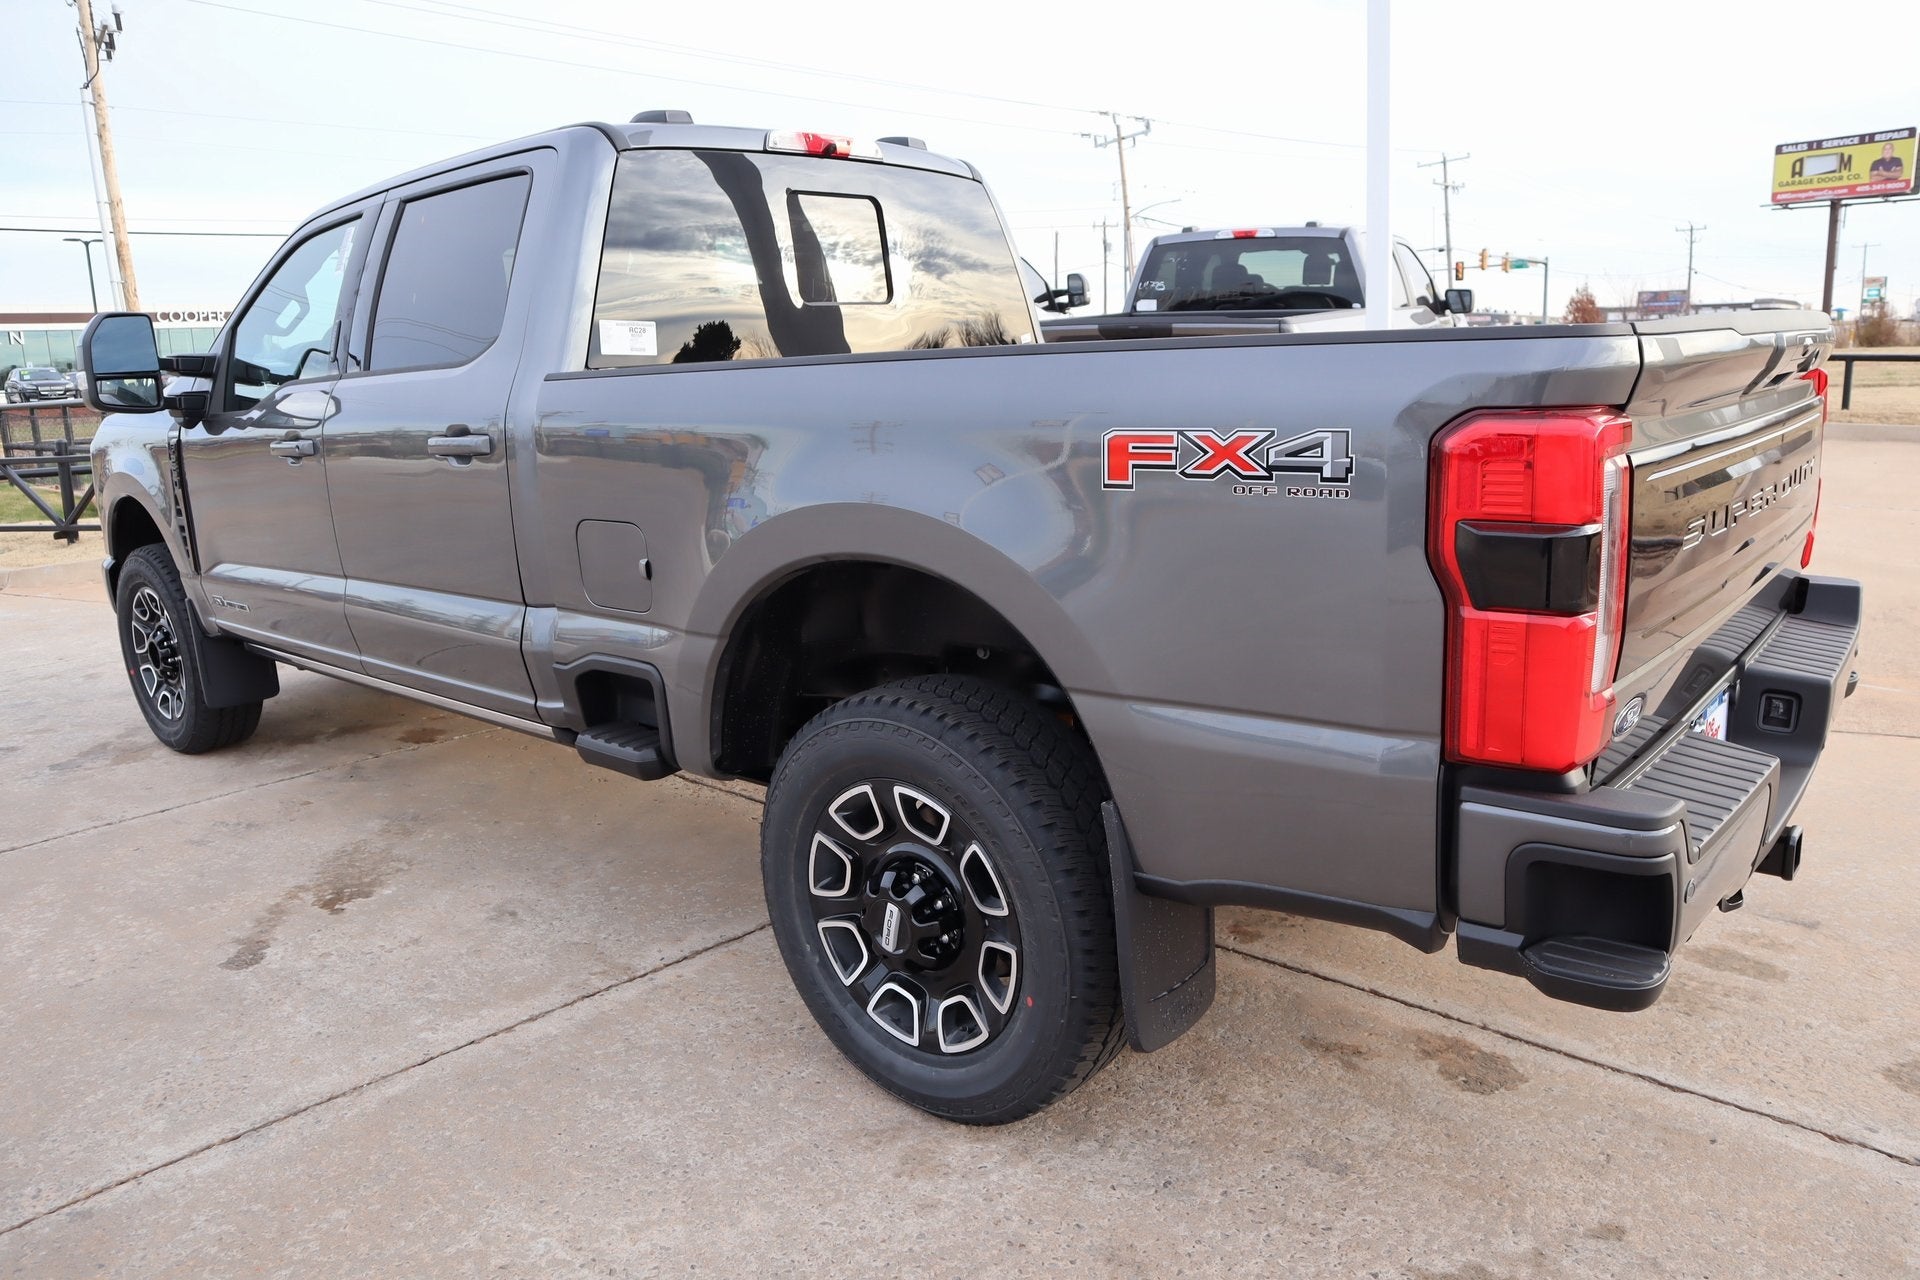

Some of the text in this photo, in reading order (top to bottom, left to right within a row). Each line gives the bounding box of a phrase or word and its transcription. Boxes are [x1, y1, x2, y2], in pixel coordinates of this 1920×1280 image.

[1781, 130, 1909, 153] SALES SERVICE REPAIR
[1778, 173, 1863, 188] GARAGE DOOR CO.
[156, 310, 227, 322] COOPER
[1101, 427, 1355, 491] FX4
[1232, 485, 1351, 499] OFF ROAD
[1682, 484, 1777, 550] SUPER
[884, 909, 894, 946] FORD
